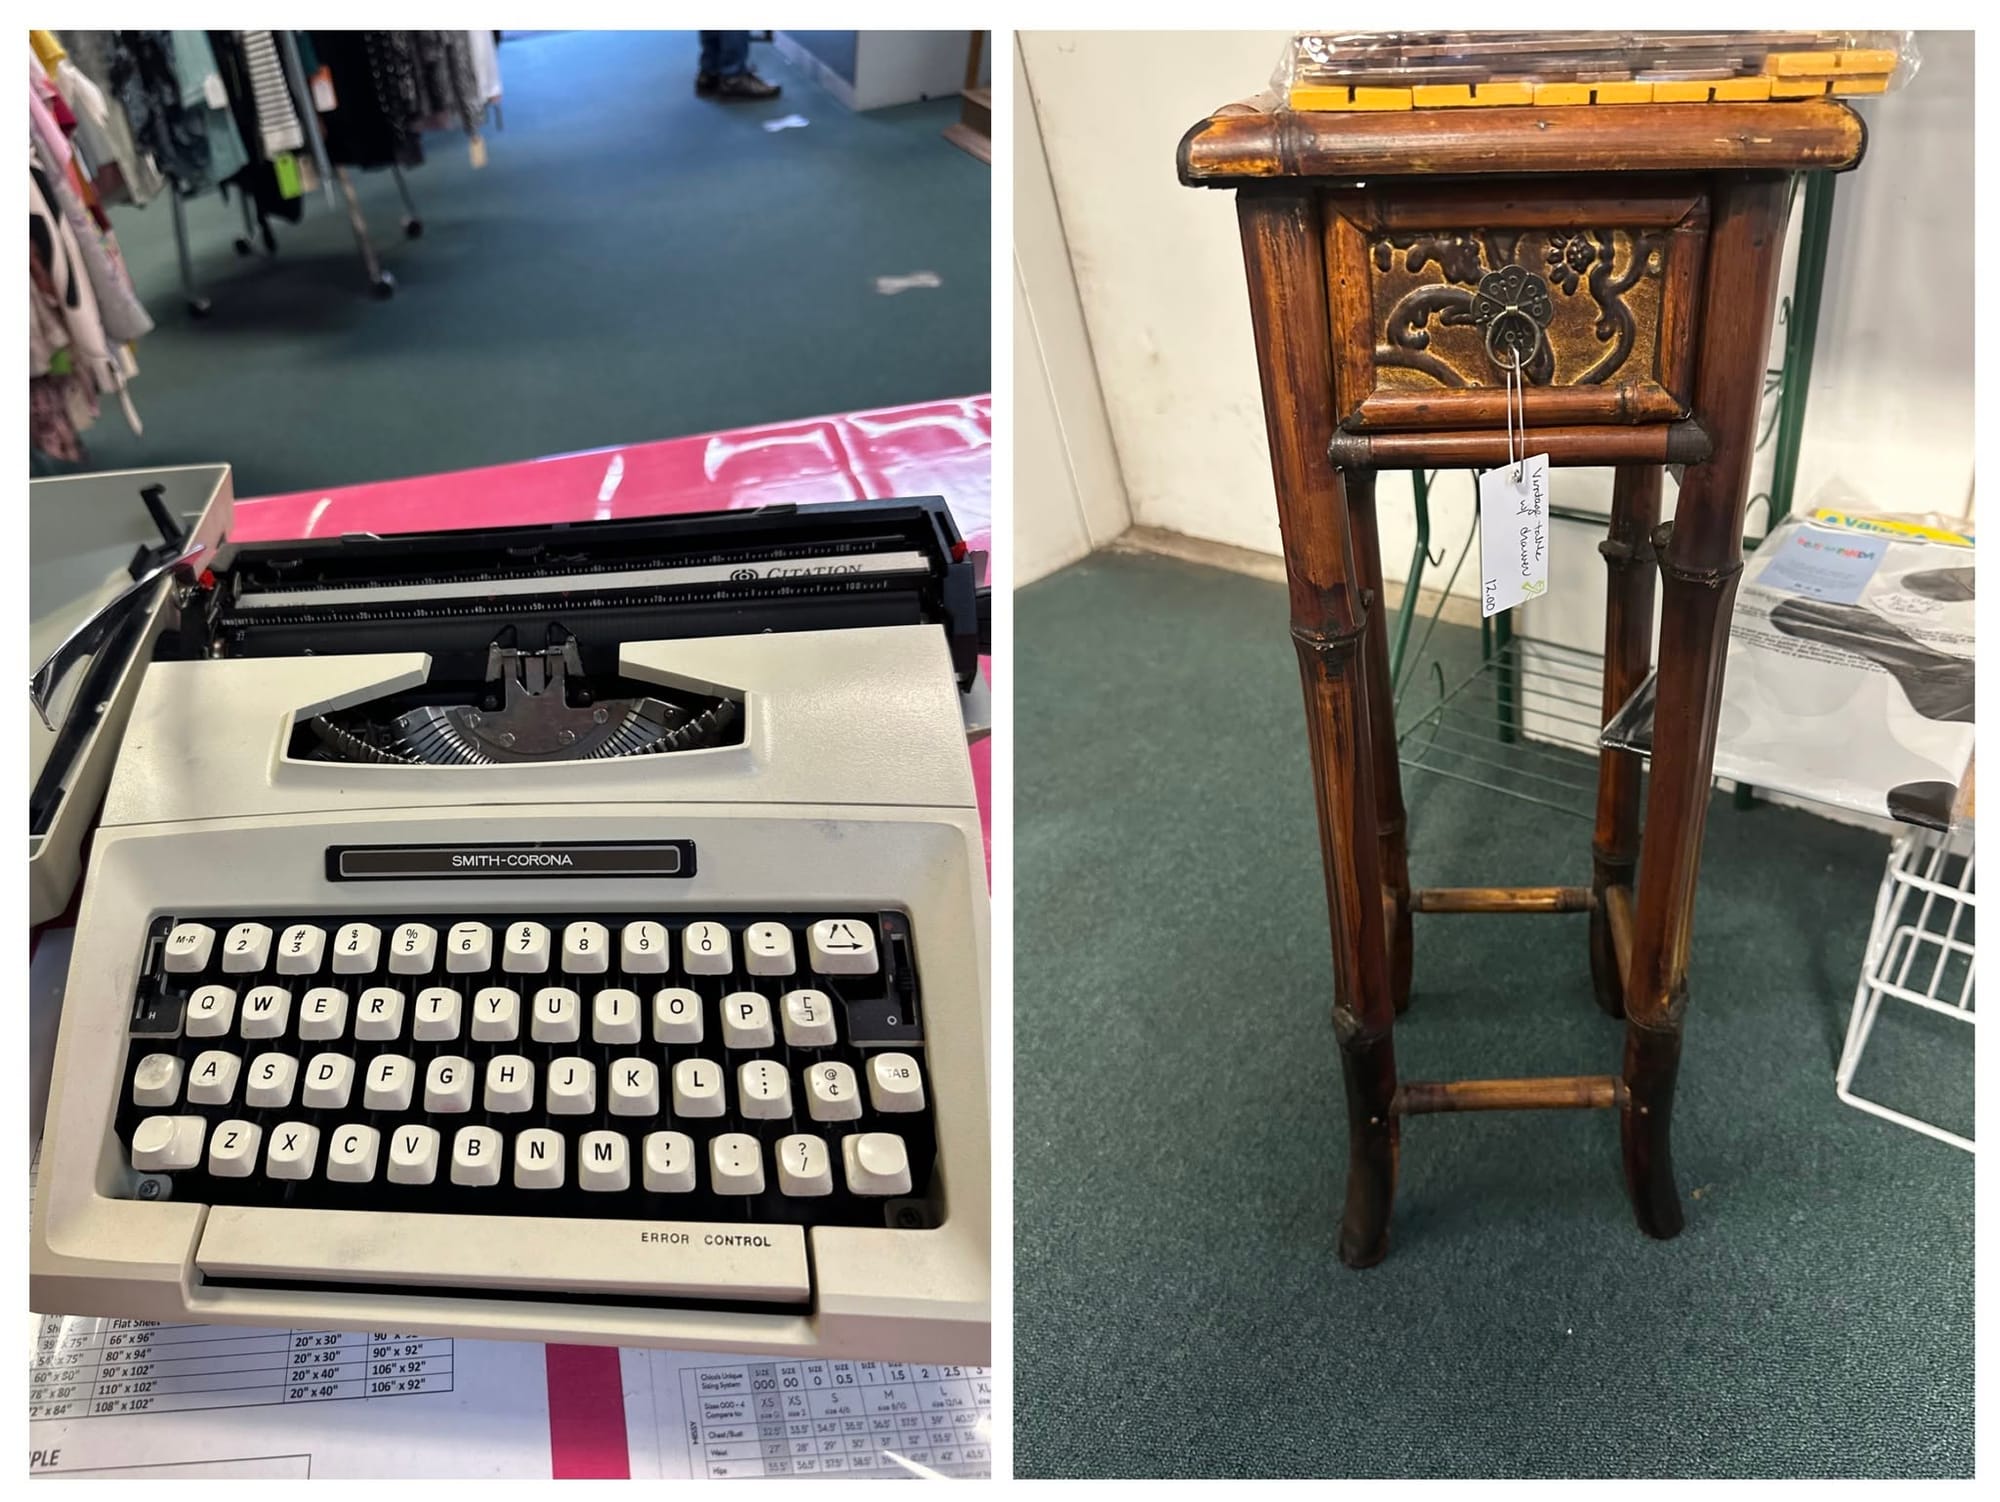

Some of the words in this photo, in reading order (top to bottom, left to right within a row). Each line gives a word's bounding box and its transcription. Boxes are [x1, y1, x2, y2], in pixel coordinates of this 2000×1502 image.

[1485, 579, 1496, 611] 12.00
[452, 853, 573, 867] SMITH-CORONA
[237, 939, 247, 951] 2
[291, 942, 302, 953] 3
[347, 940, 358, 951] 4
[405, 940, 415, 952] 5
[461, 939, 471, 951] 6
[520, 938, 530, 950] 7
[579, 938, 589, 951] 8
[639, 938, 649, 951] 9
[201, 995, 215, 1010] Q
[254, 996, 274, 1012] W
[314, 998, 327, 1013] E
[370, 998, 385, 1014] R
[430, 997, 442, 1013] T
[489, 998, 501, 1014] Y
[548, 998, 561, 1014] U
[740, 1004, 753, 1020] P
[202, 1061, 217, 1077] A
[262, 1063, 275, 1080] S
[318, 1064, 334, 1080] D
[381, 1065, 394, 1082] F
[439, 1067, 453, 1084] G
[500, 1066, 515, 1083] H
[563, 1068, 574, 1085] J
[627, 1070, 640, 1087] K
[693, 1070, 705, 1088] L
[223, 1132, 238, 1149] Z
[282, 1133, 298, 1151] X
[344, 1136, 358, 1154] C
[406, 1136, 419, 1154] V
[467, 1139, 481, 1156] B
[530, 1141, 545, 1159] N
[594, 1142, 612, 1161] M
[641, 1232, 690, 1244] ERROR
[704, 1234, 771, 1247] CONTROL
[110, 1334, 127, 1345] 66"
[137, 1332, 154, 1343] 96"
[295, 1336, 313, 1347] 20"
[324, 1334, 342, 1345] 30"
[106, 1351, 124, 1361] 80"
[134, 1349, 151, 1359] 94"
[294, 1352, 312, 1364] 20"
[323, 1351, 341, 1362] 30"
[373, 1347, 391, 1358] 90"
[405, 1344, 423, 1355] 92"
[103, 1367, 120, 1378] 90"
[131, 1364, 154, 1376] 102"
[292, 1369, 310, 1381] 20"
[321, 1368, 339, 1379] 40"
[372, 1363, 397, 1375] 106"
[408, 1361, 426, 1372] 92"
[372, 1381, 396, 1392] 106"
[408, 1378, 426, 1389] 92"
[754, 1379, 776, 1390] 000
[783, 1377, 799, 1388] 00
[814, 1376, 822, 1386] 0
[836, 1374, 853, 1384] 0.5
[892, 1370, 905, 1381] 1.5
[922, 1369, 929, 1378] 2
[944, 1367, 961, 1377] 2.5
[99, 1384, 122, 1395] 110"
[133, 1381, 157, 1392] 102"
[291, 1387, 309, 1398] 20"
[319, 1385, 338, 1396] 40"
[95, 1401, 119, 1412] 108"
[130, 1398, 154, 1409] 102"
[29, 1449, 61, 1467] PLE
